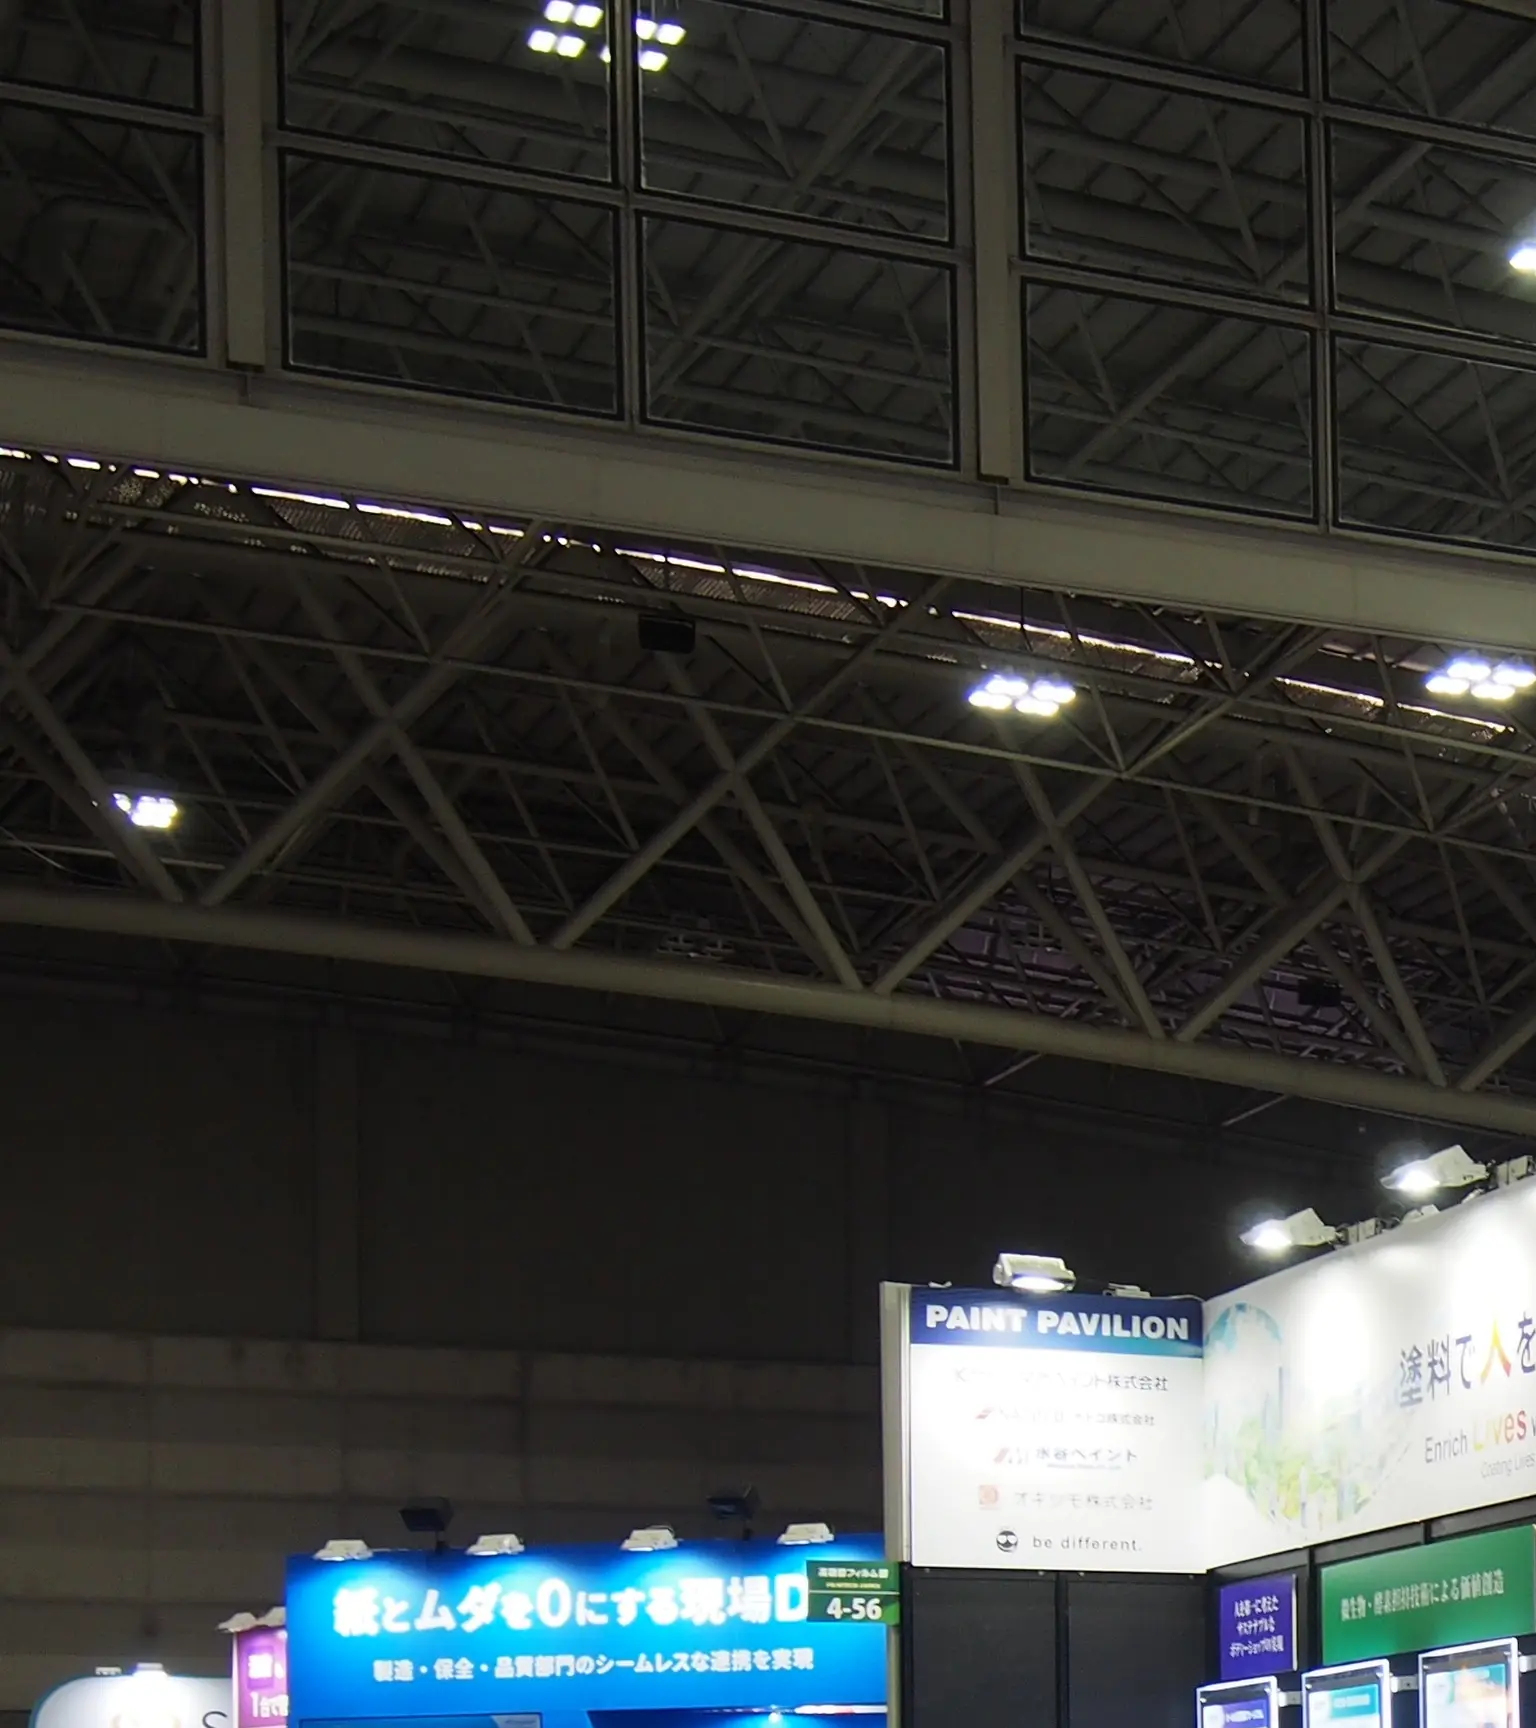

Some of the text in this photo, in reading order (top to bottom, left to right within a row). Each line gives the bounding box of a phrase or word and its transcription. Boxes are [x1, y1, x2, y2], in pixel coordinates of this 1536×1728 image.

[926, 1304, 1189, 1340] PAINT PAVILION
[1424, 1429, 1468, 1464] Enrich
[1033, 1537, 1143, 1551] be different.
[826, 1597, 882, 1621] 4-56
